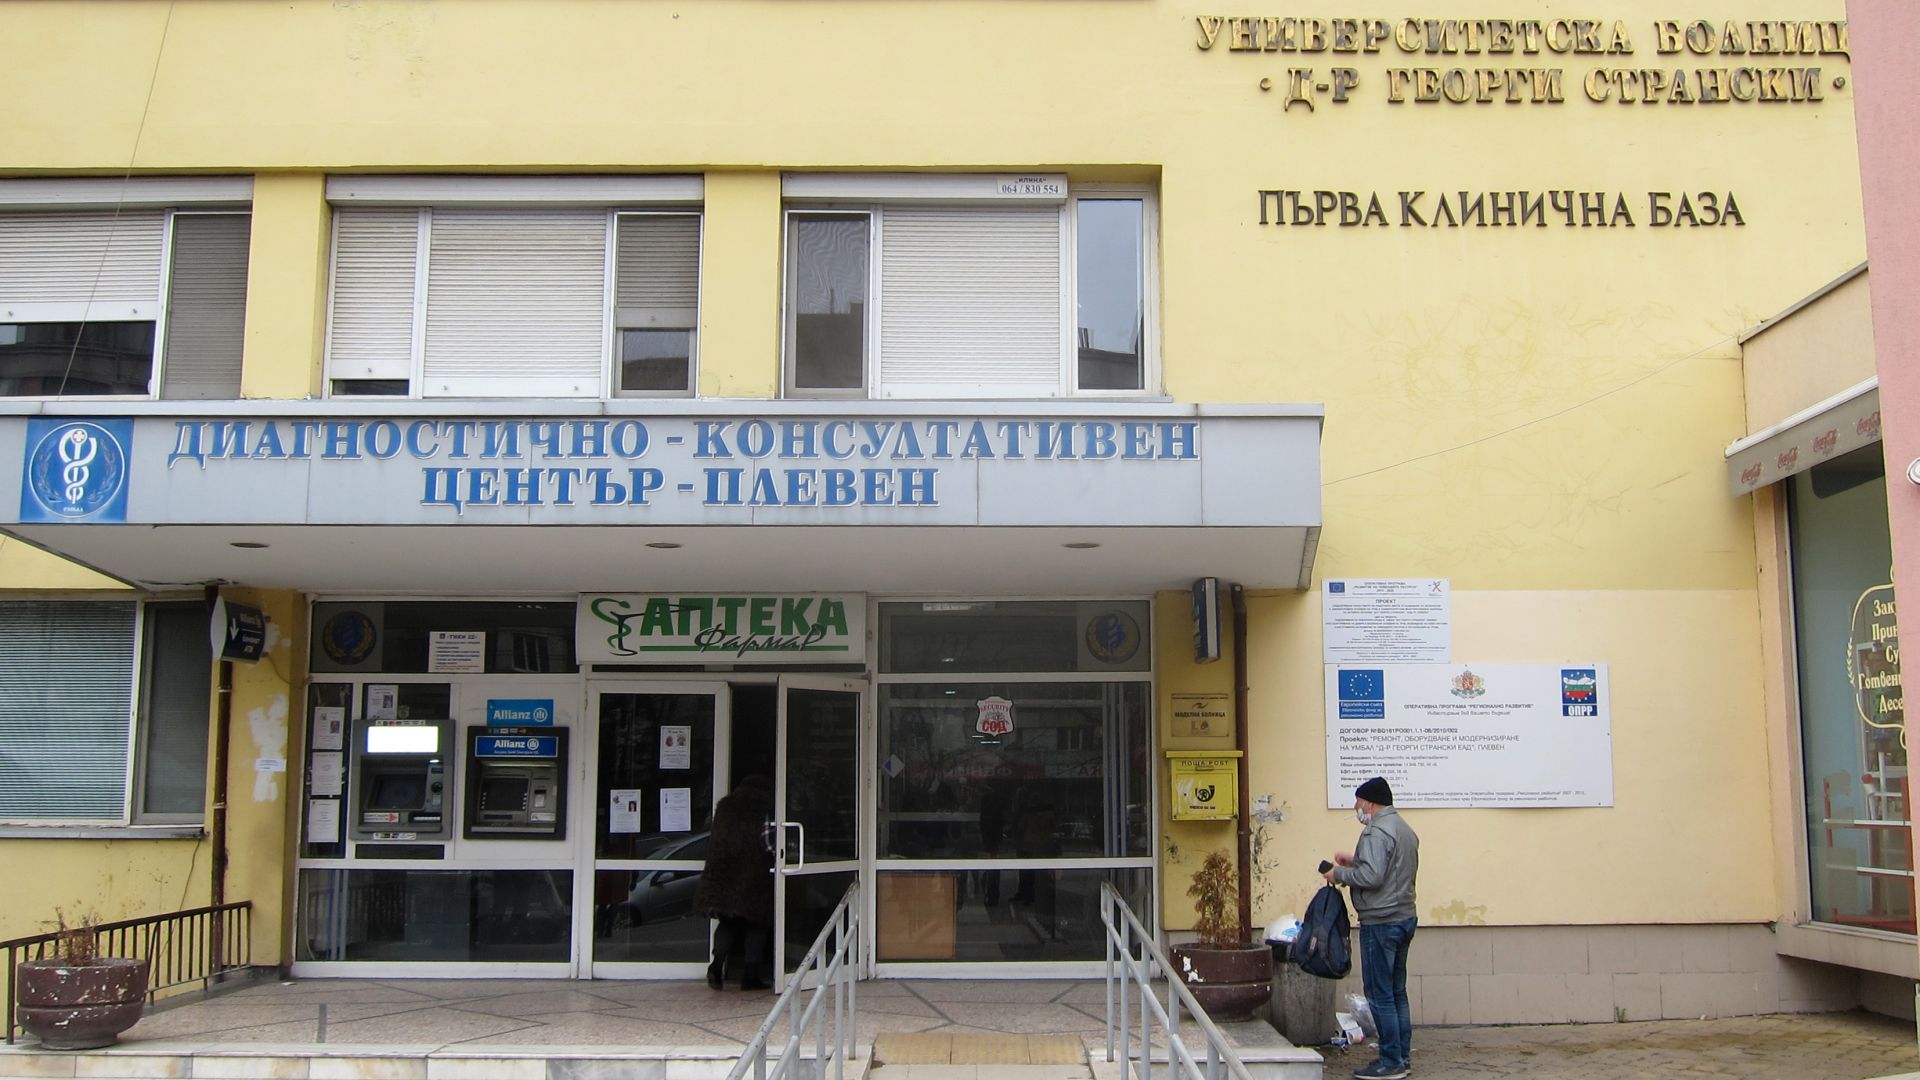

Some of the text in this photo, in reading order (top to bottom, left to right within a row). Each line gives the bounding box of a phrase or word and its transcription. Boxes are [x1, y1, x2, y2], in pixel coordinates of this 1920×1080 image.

[1196, 16, 1634, 56] УНИВЕРСИТЕТСКА
[1284, 67, 1825, 112] Д-Р ГЕОРГИ СТРАНСКИ
[1002, 184, 1017, 194] 064
[1025, 184, 1041, 194] 830
[1043, 184, 1059, 194] 554
[1258, 189, 1745, 227] ПЪРВА КЛИНИЧНА БАЗА
[168, 419, 652, 470] ДИАГНОСТИЧНО
[692, 419, 1202, 461] КОНСУЛТАТИВЕН
[420, 467, 665, 515] ЦЕНТЪР
[702, 468, 941, 508] ПЛЕВЕН
[639, 597, 850, 636] АПТЕКА
[1873, 599, 1896, 617] Зак
[492, 709, 531, 720] Allianz
[1568, 705, 1593, 716] ОПРР
[494, 739, 526, 748] Allianz
